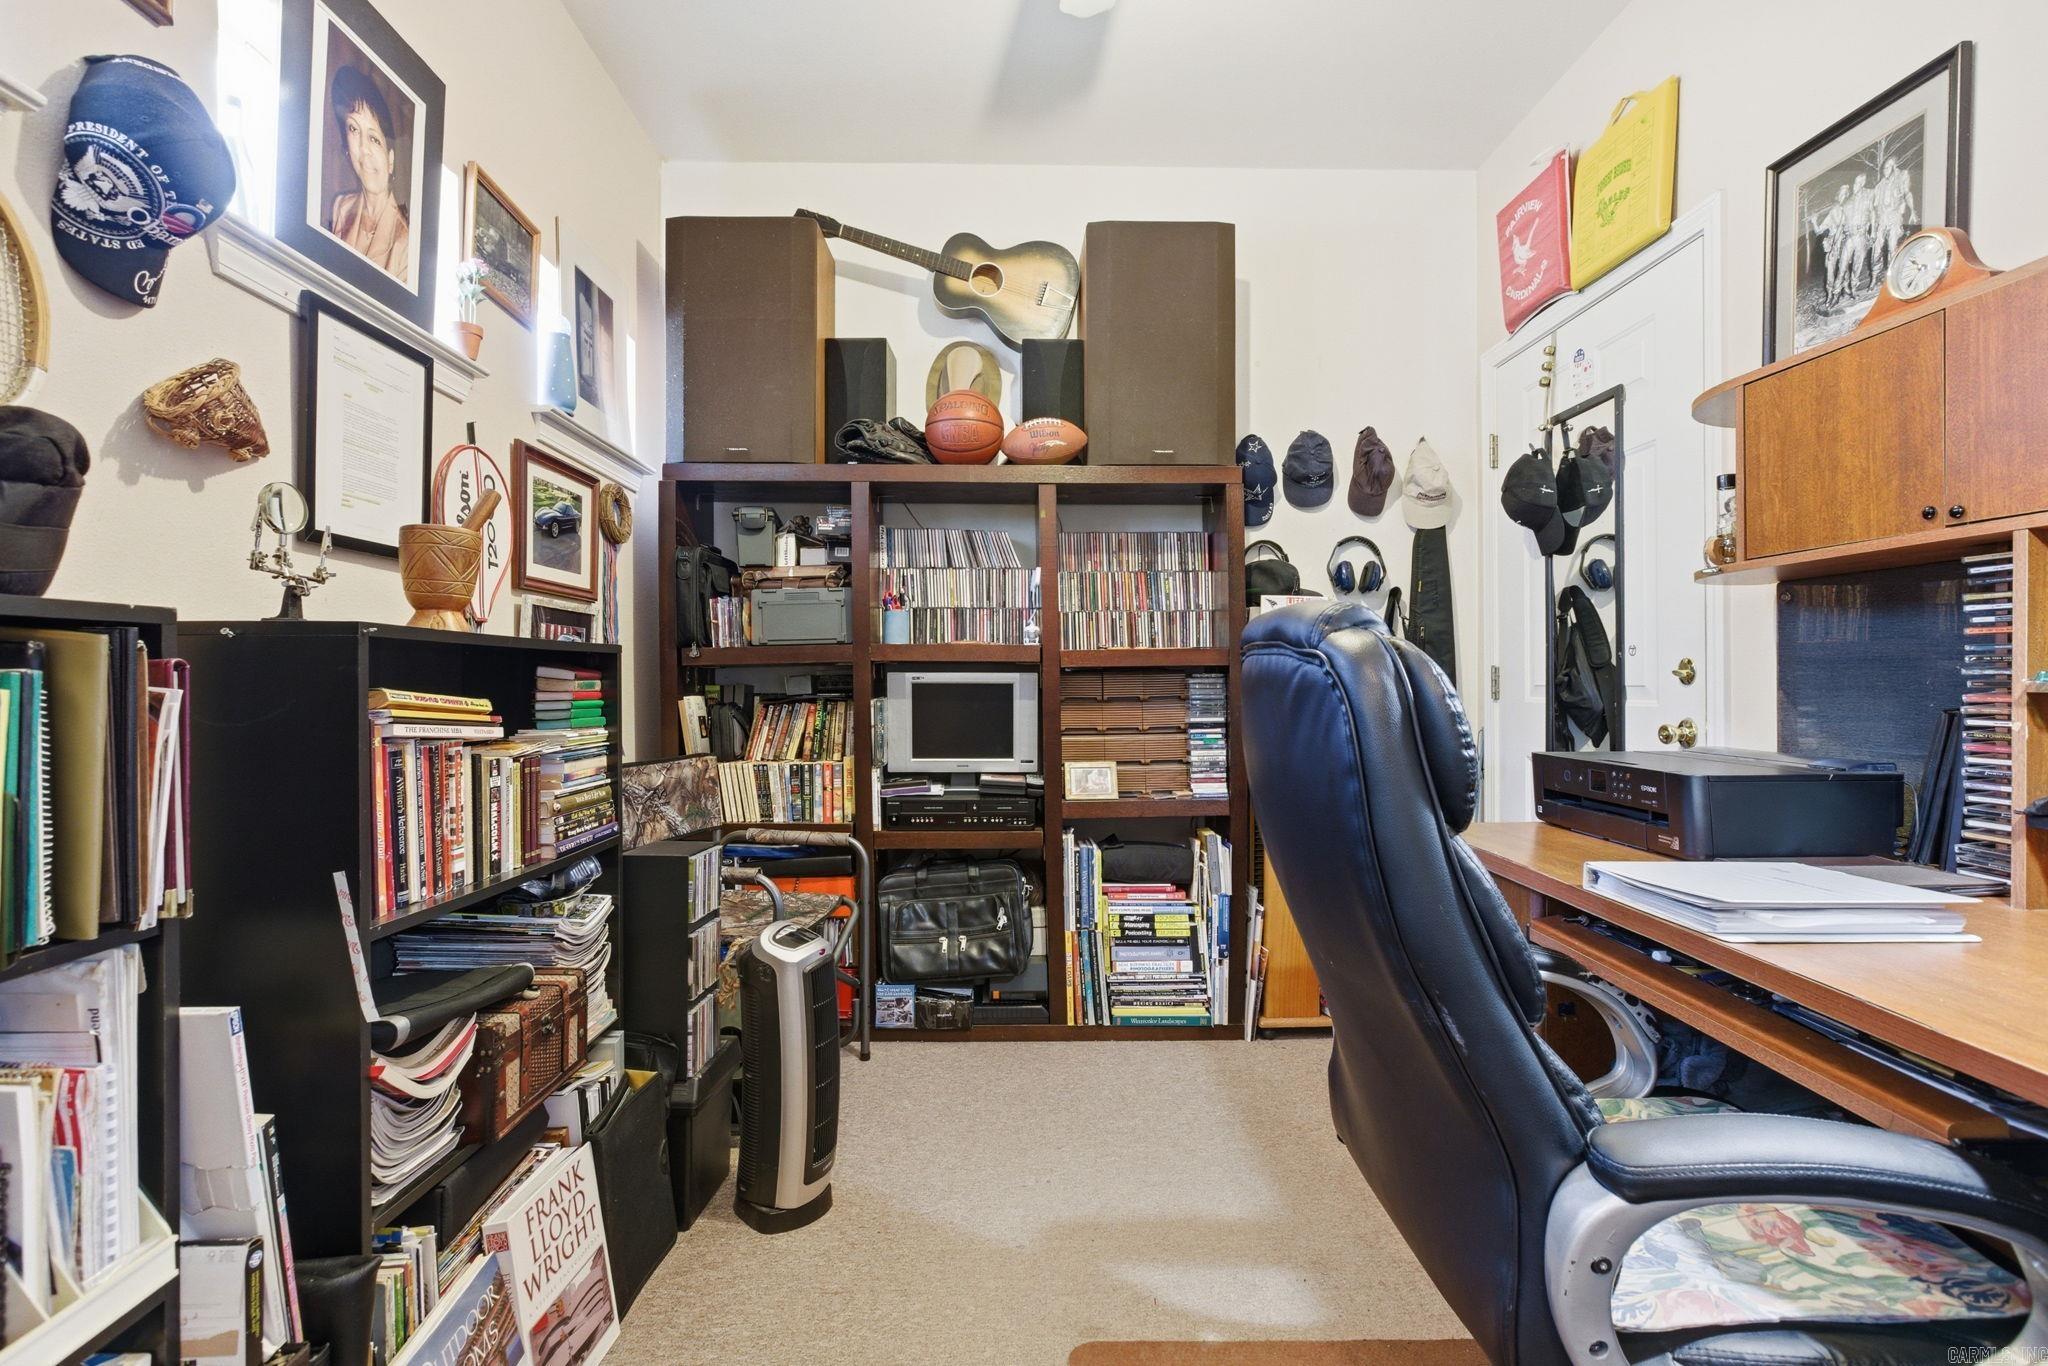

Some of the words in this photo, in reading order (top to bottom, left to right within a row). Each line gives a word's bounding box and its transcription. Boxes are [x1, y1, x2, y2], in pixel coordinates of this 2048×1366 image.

[67, 121, 149, 160] PRESIDENT
[150, 164, 170, 184] OF
[57, 219, 121, 250] STATES
[1506, 199, 1544, 238] FAIRVIEW
[1505, 259, 1548, 301] CARDINALS
[933, 401, 990, 419] SPALDING
[397, 815, 406, 855] Reference
[491, 853, 499, 861] X
[525, 1159, 586, 1236] FRANK
[530, 1190, 586, 1265] LLOYD
[523, 1204, 597, 1302] WRIGHT
